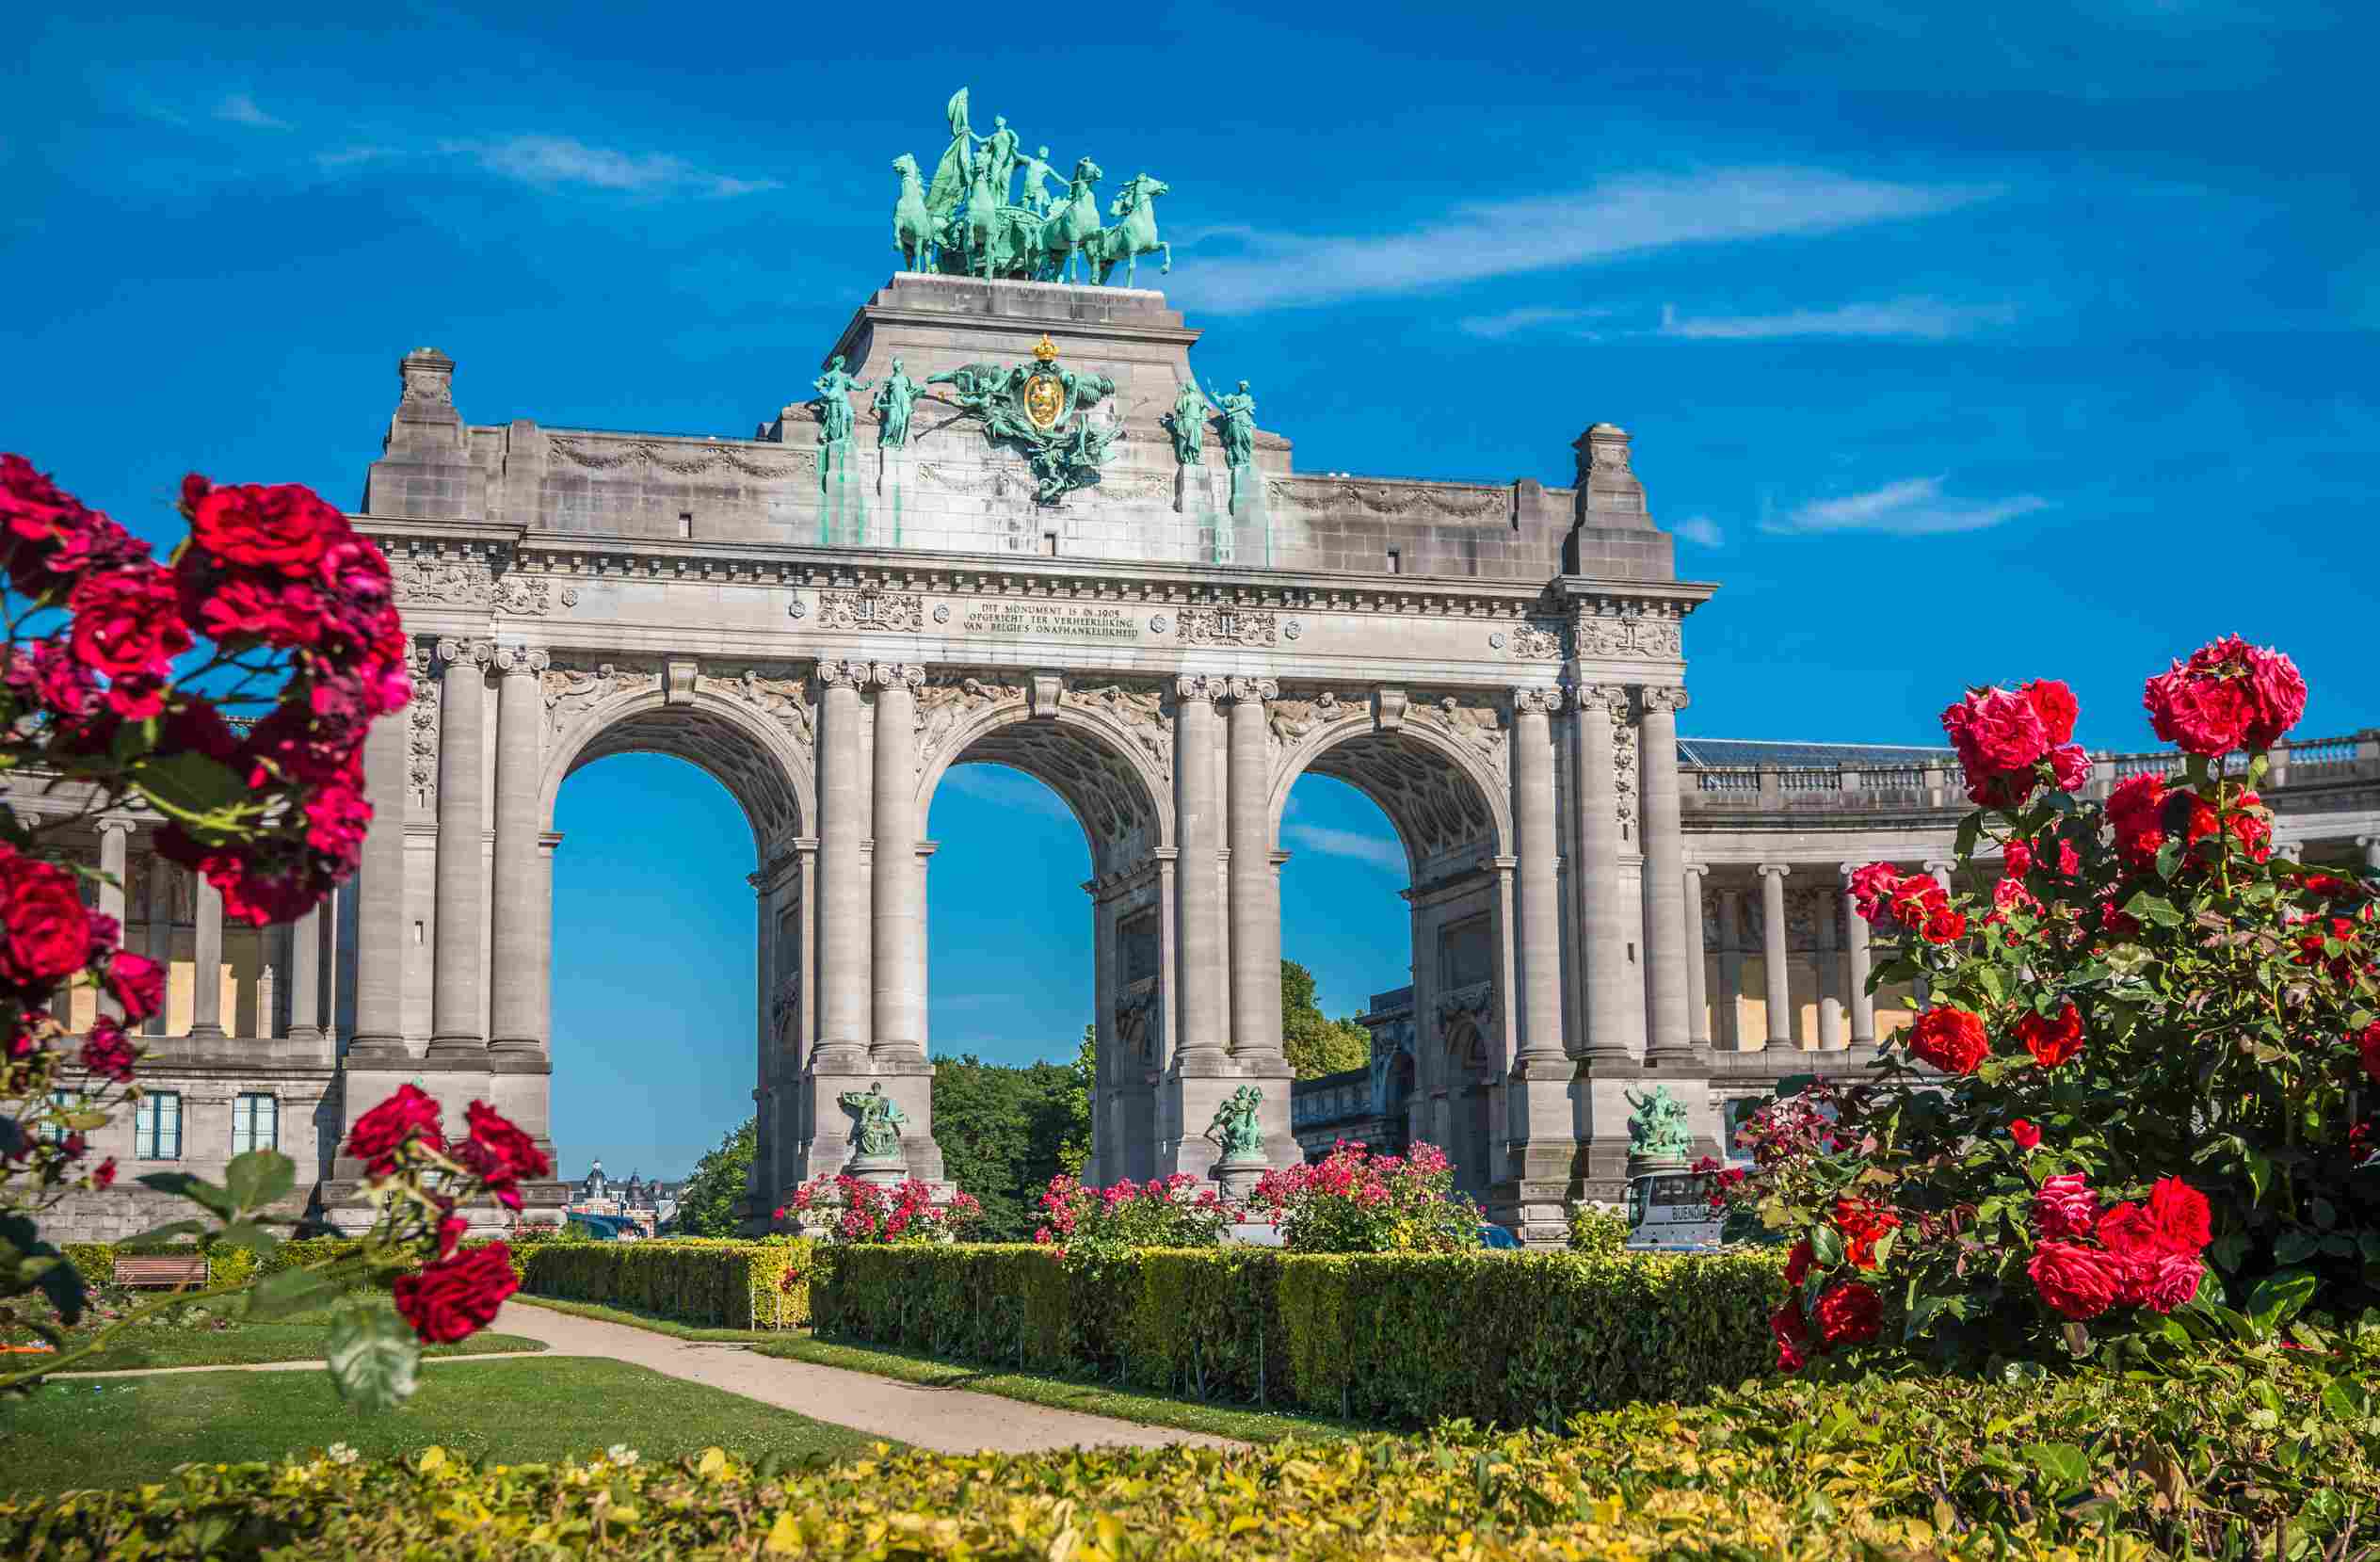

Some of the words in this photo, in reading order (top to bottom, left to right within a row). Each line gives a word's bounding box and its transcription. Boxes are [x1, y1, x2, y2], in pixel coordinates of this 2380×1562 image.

[982, 604, 999, 612] DIT
[1005, 604, 1062, 616] MONUMENT
[1069, 607, 1078, 616] IS
[970, 613, 1024, 623] OPGERICHT
[1031, 616, 1048, 624] TER
[964, 621, 983, 631] VAN
